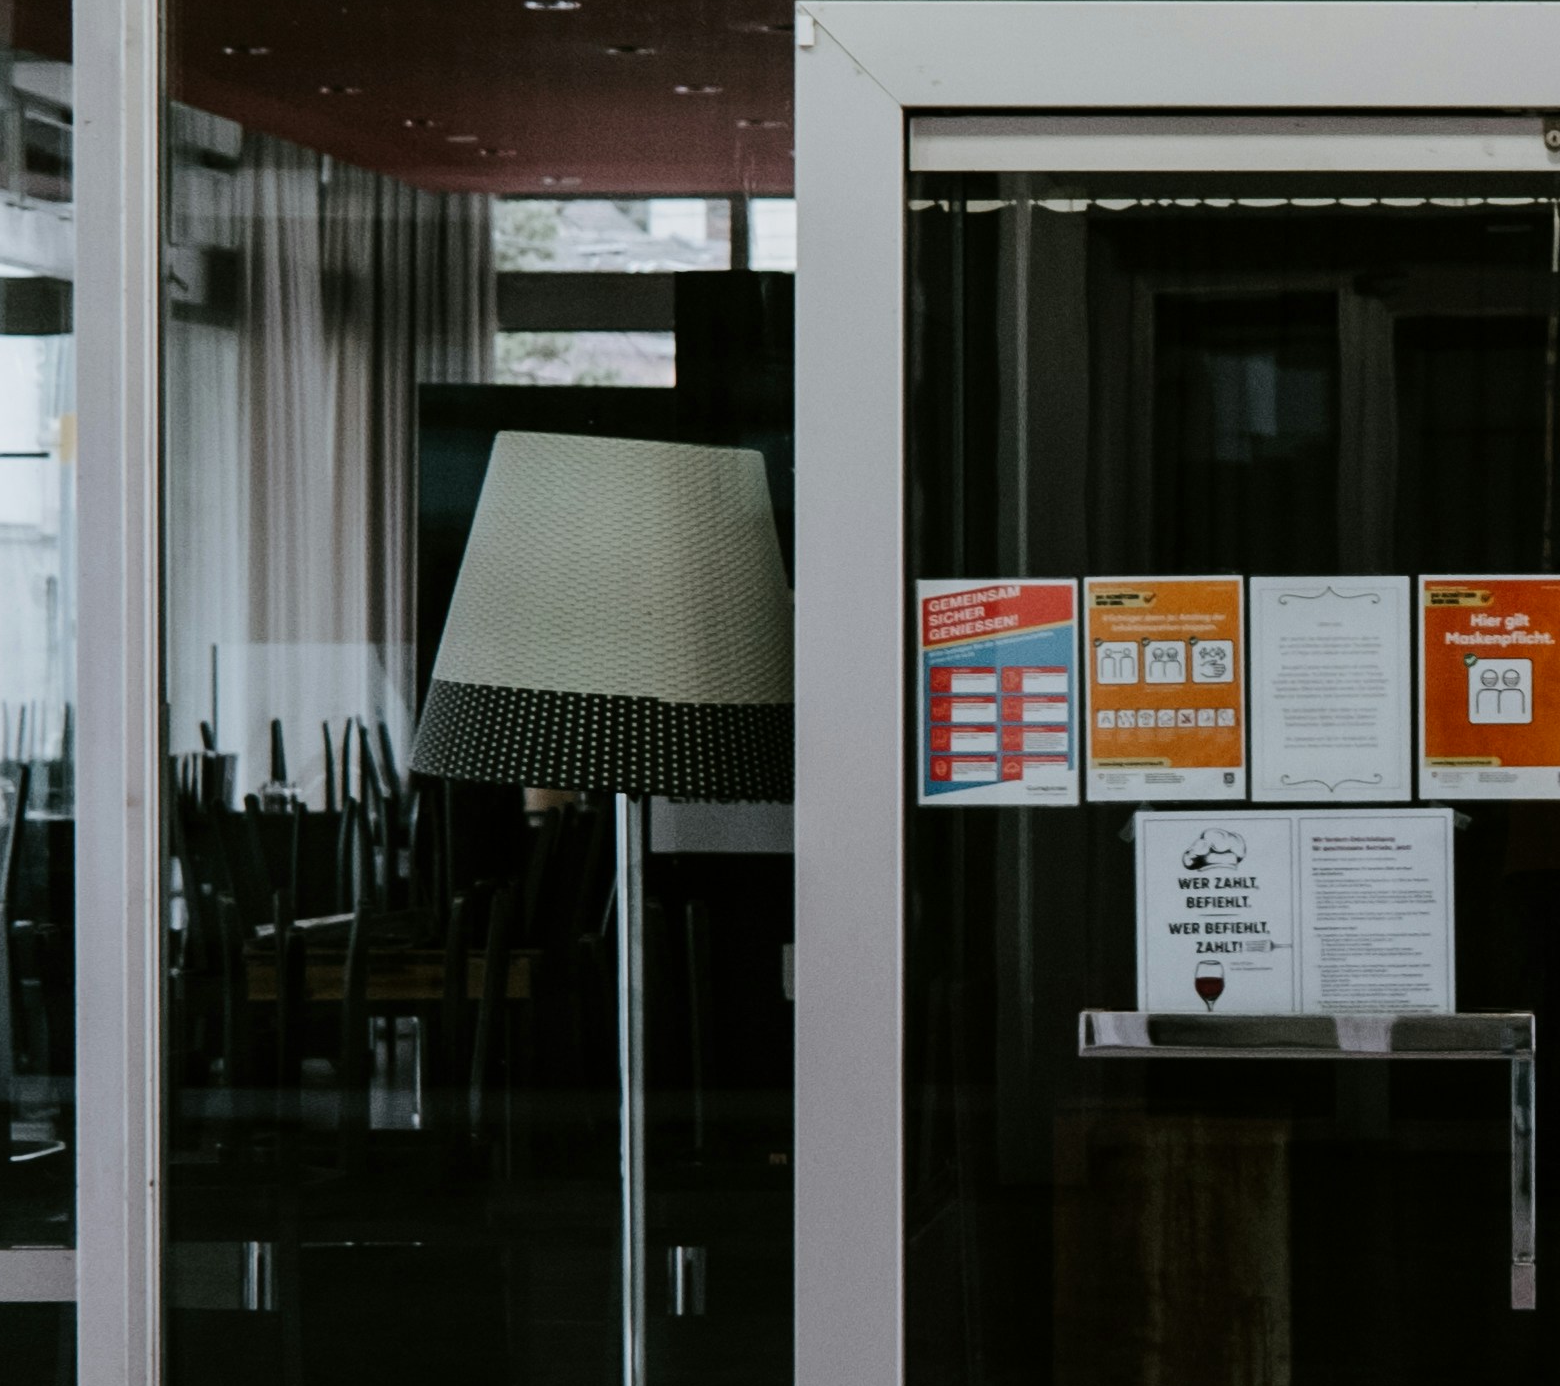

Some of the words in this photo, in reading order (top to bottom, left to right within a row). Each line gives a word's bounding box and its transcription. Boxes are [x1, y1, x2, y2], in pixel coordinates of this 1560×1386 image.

[928, 585, 1021, 612] GEMEINSAM
[928, 606, 985, 627] SICHER
[1470, 614, 1501, 627] Hier
[1504, 613, 1531, 630] gilt
[928, 615, 1019, 641] GENIESSEN!
[1445, 631, 1556, 648] Maskenpflicht.
[1177, 877, 1210, 890] WER
[1214, 876, 1260, 890] ZAHLT,
[1186, 895, 1252, 909] BEFIEHLT.
[1168, 922, 1200, 935] WER
[1204, 921, 1270, 935] BEFIEHLT,
[1195, 941, 1243, 954] ZAHLT!
